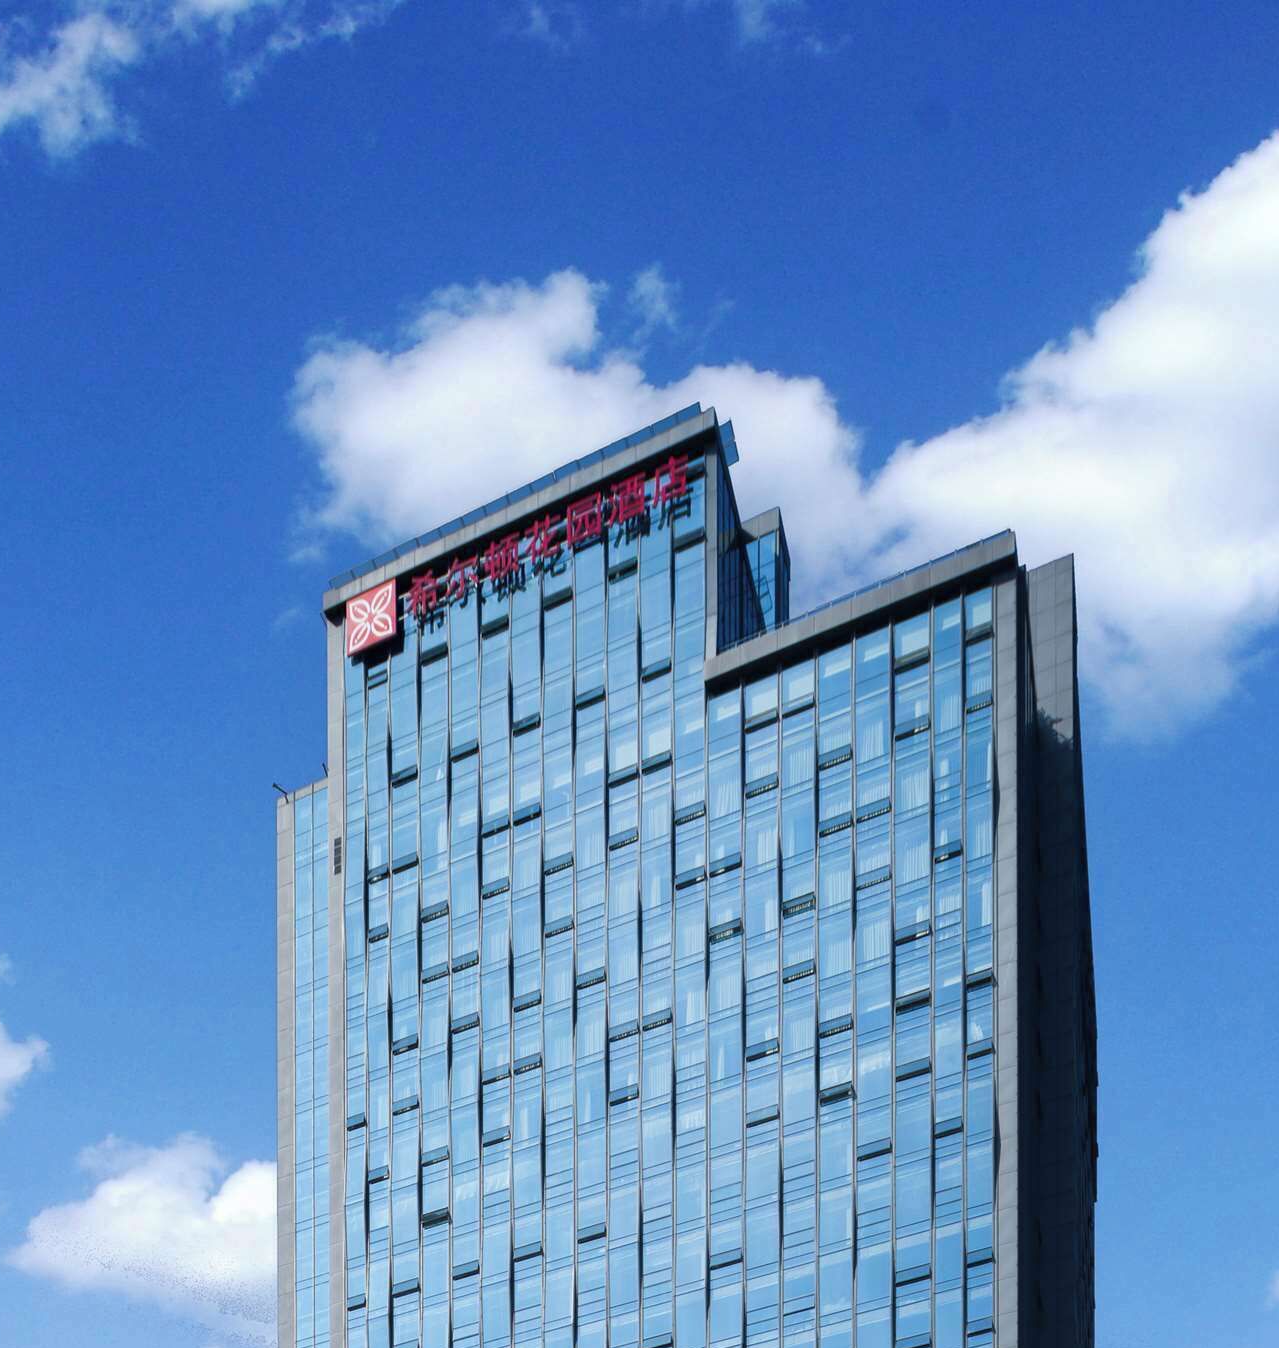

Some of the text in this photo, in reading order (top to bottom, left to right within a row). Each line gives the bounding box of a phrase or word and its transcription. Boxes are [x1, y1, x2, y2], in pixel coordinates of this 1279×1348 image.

[409, 455, 689, 615] 希尔顿花园酒店
